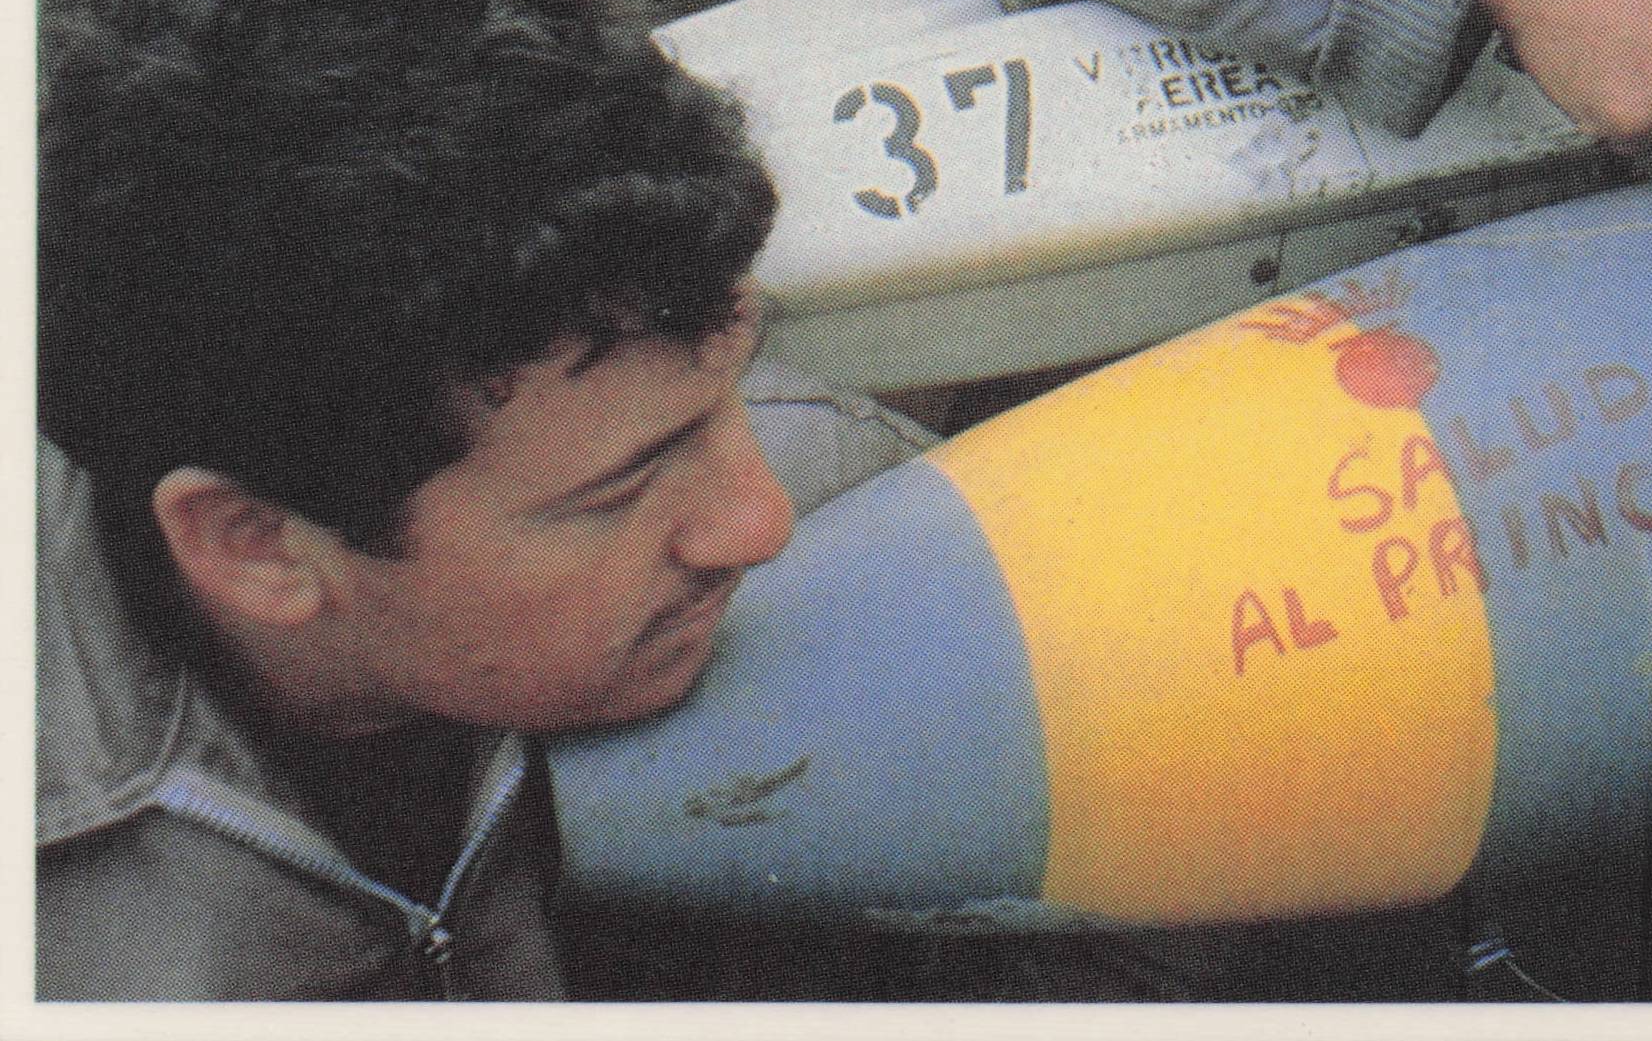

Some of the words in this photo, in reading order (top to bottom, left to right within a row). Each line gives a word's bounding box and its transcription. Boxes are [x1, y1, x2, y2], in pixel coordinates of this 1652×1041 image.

[1073, 47, 1101, 82] V
[832, 58, 1032, 219] 37
[1229, 585, 1338, 676] AL
